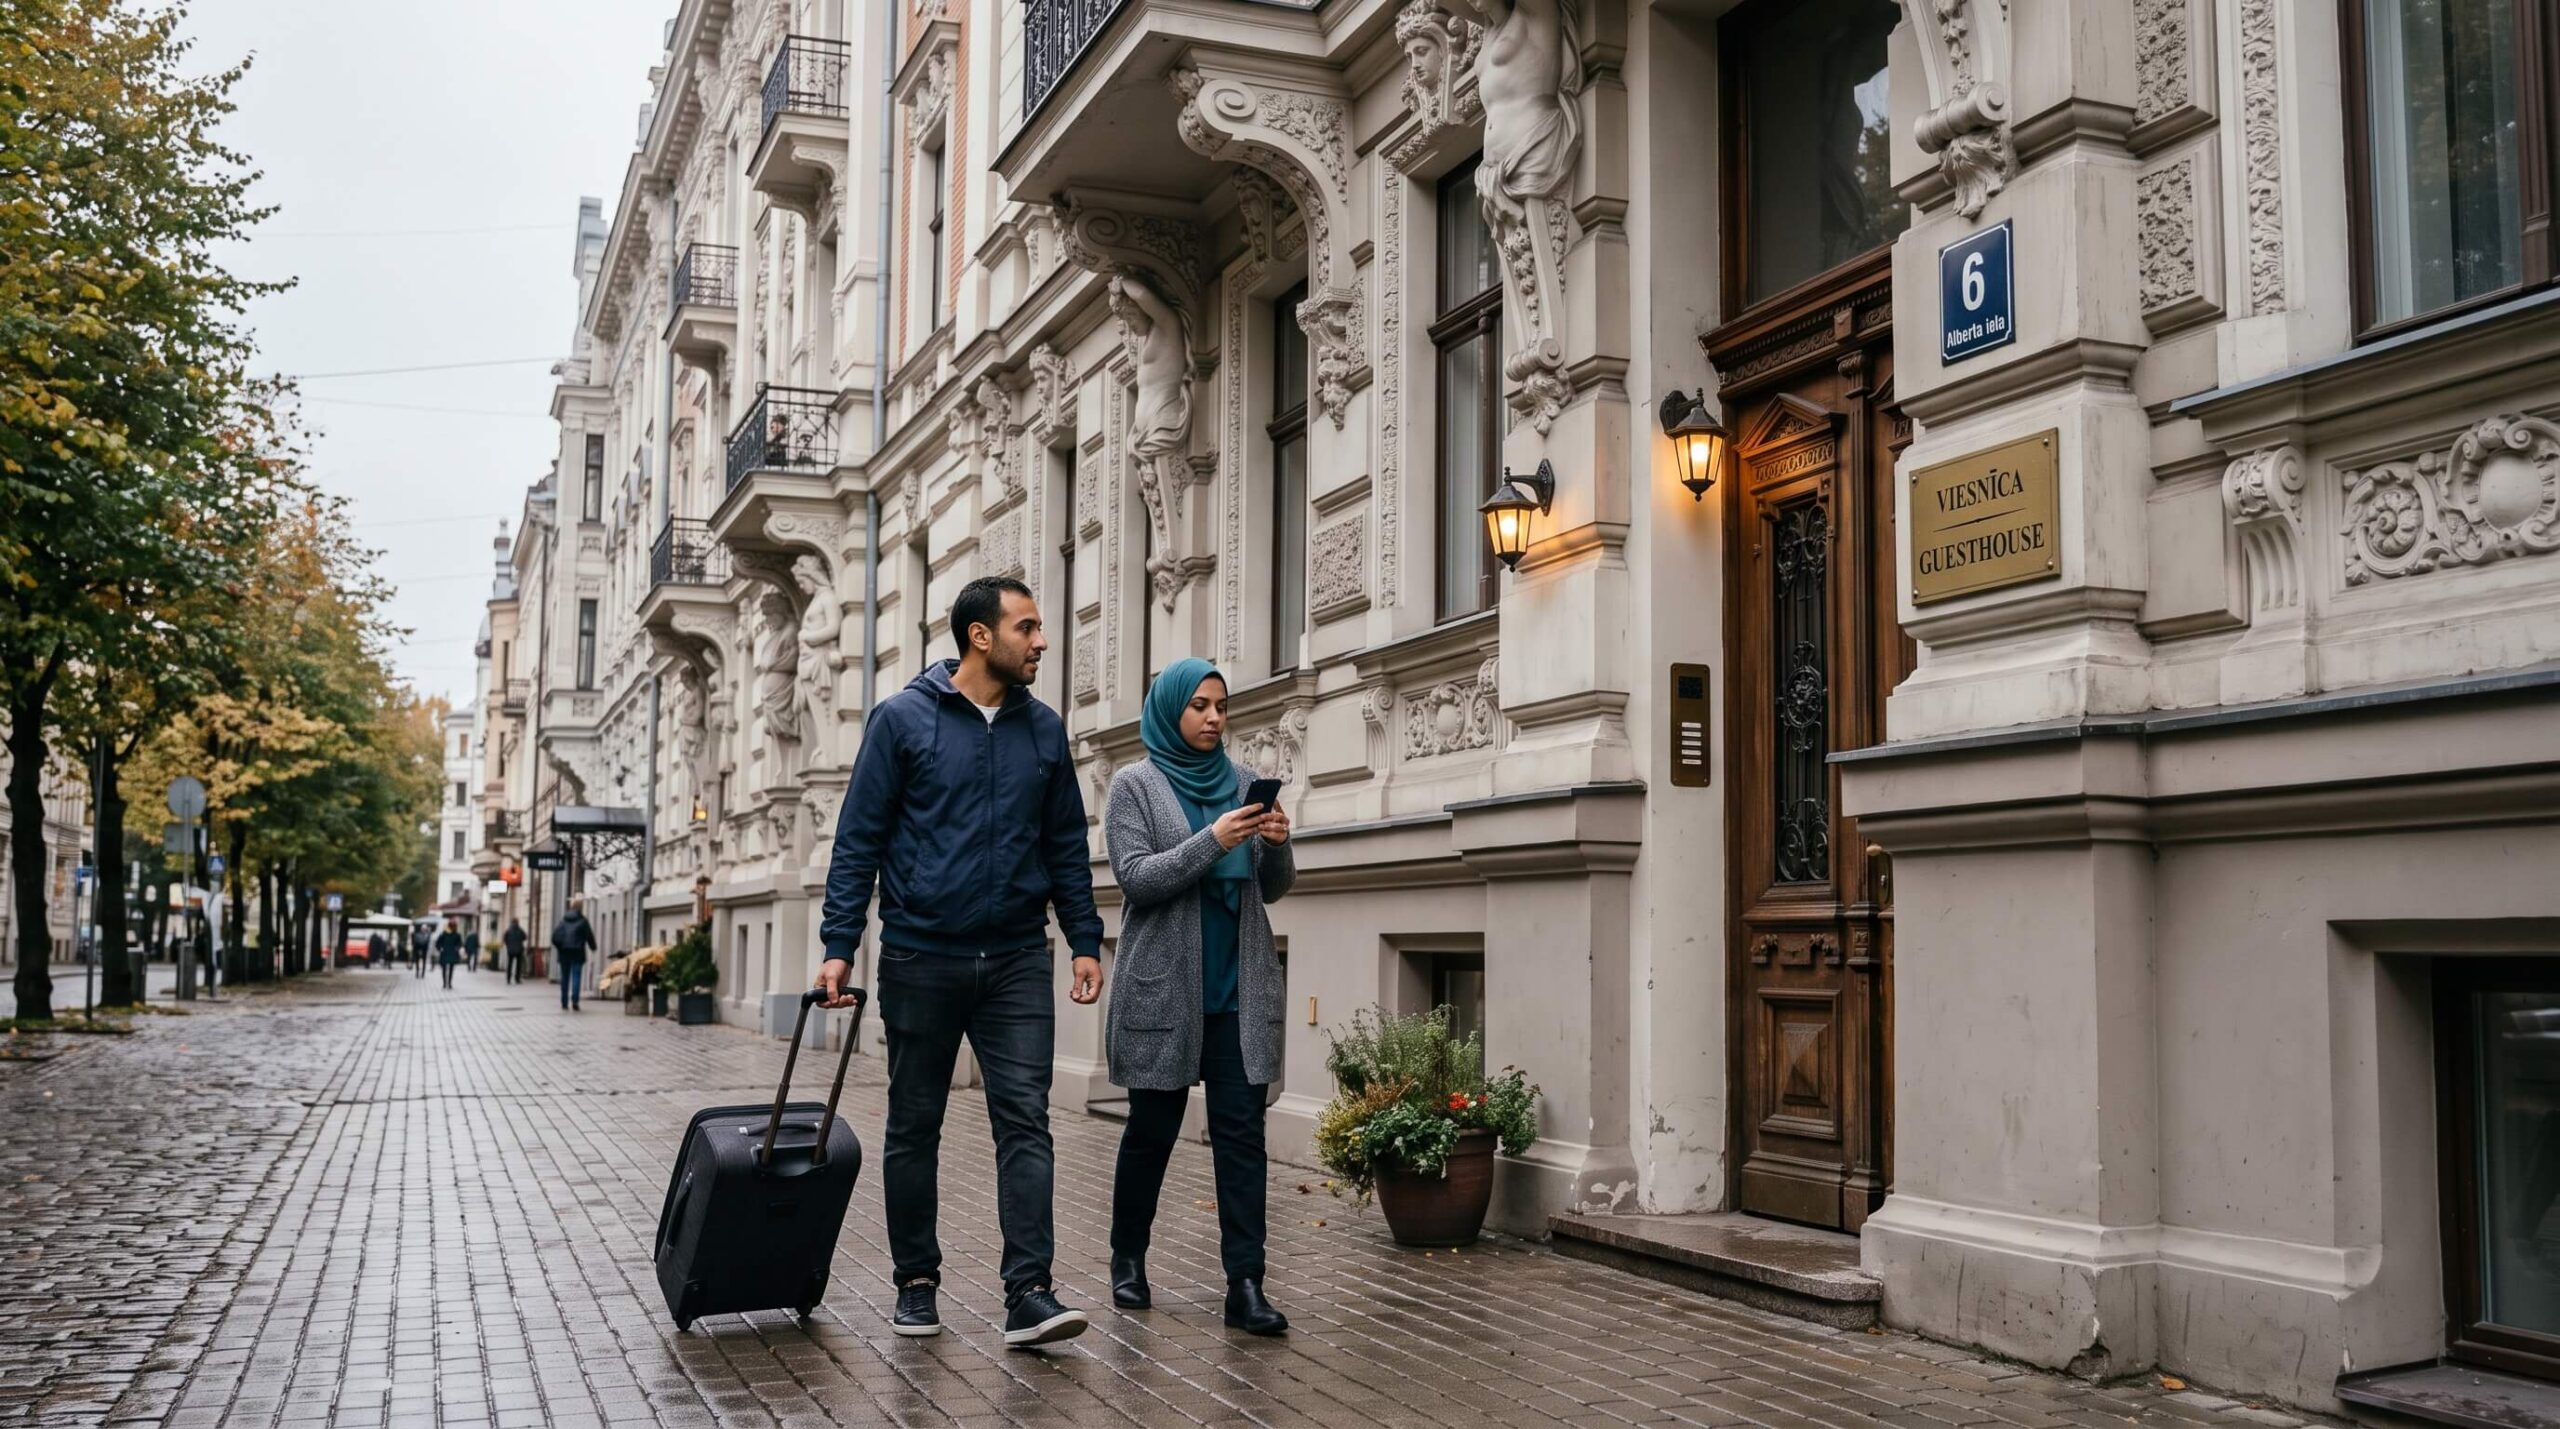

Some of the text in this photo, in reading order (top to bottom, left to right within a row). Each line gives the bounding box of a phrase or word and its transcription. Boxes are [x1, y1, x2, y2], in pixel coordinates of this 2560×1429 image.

[1962, 251, 1985, 311] 6
[1947, 314, 2005, 348] Alberta iela
[1936, 468, 2024, 513] VIESNĪCA
[1919, 522, 2045, 575] GUESTHOUSE
